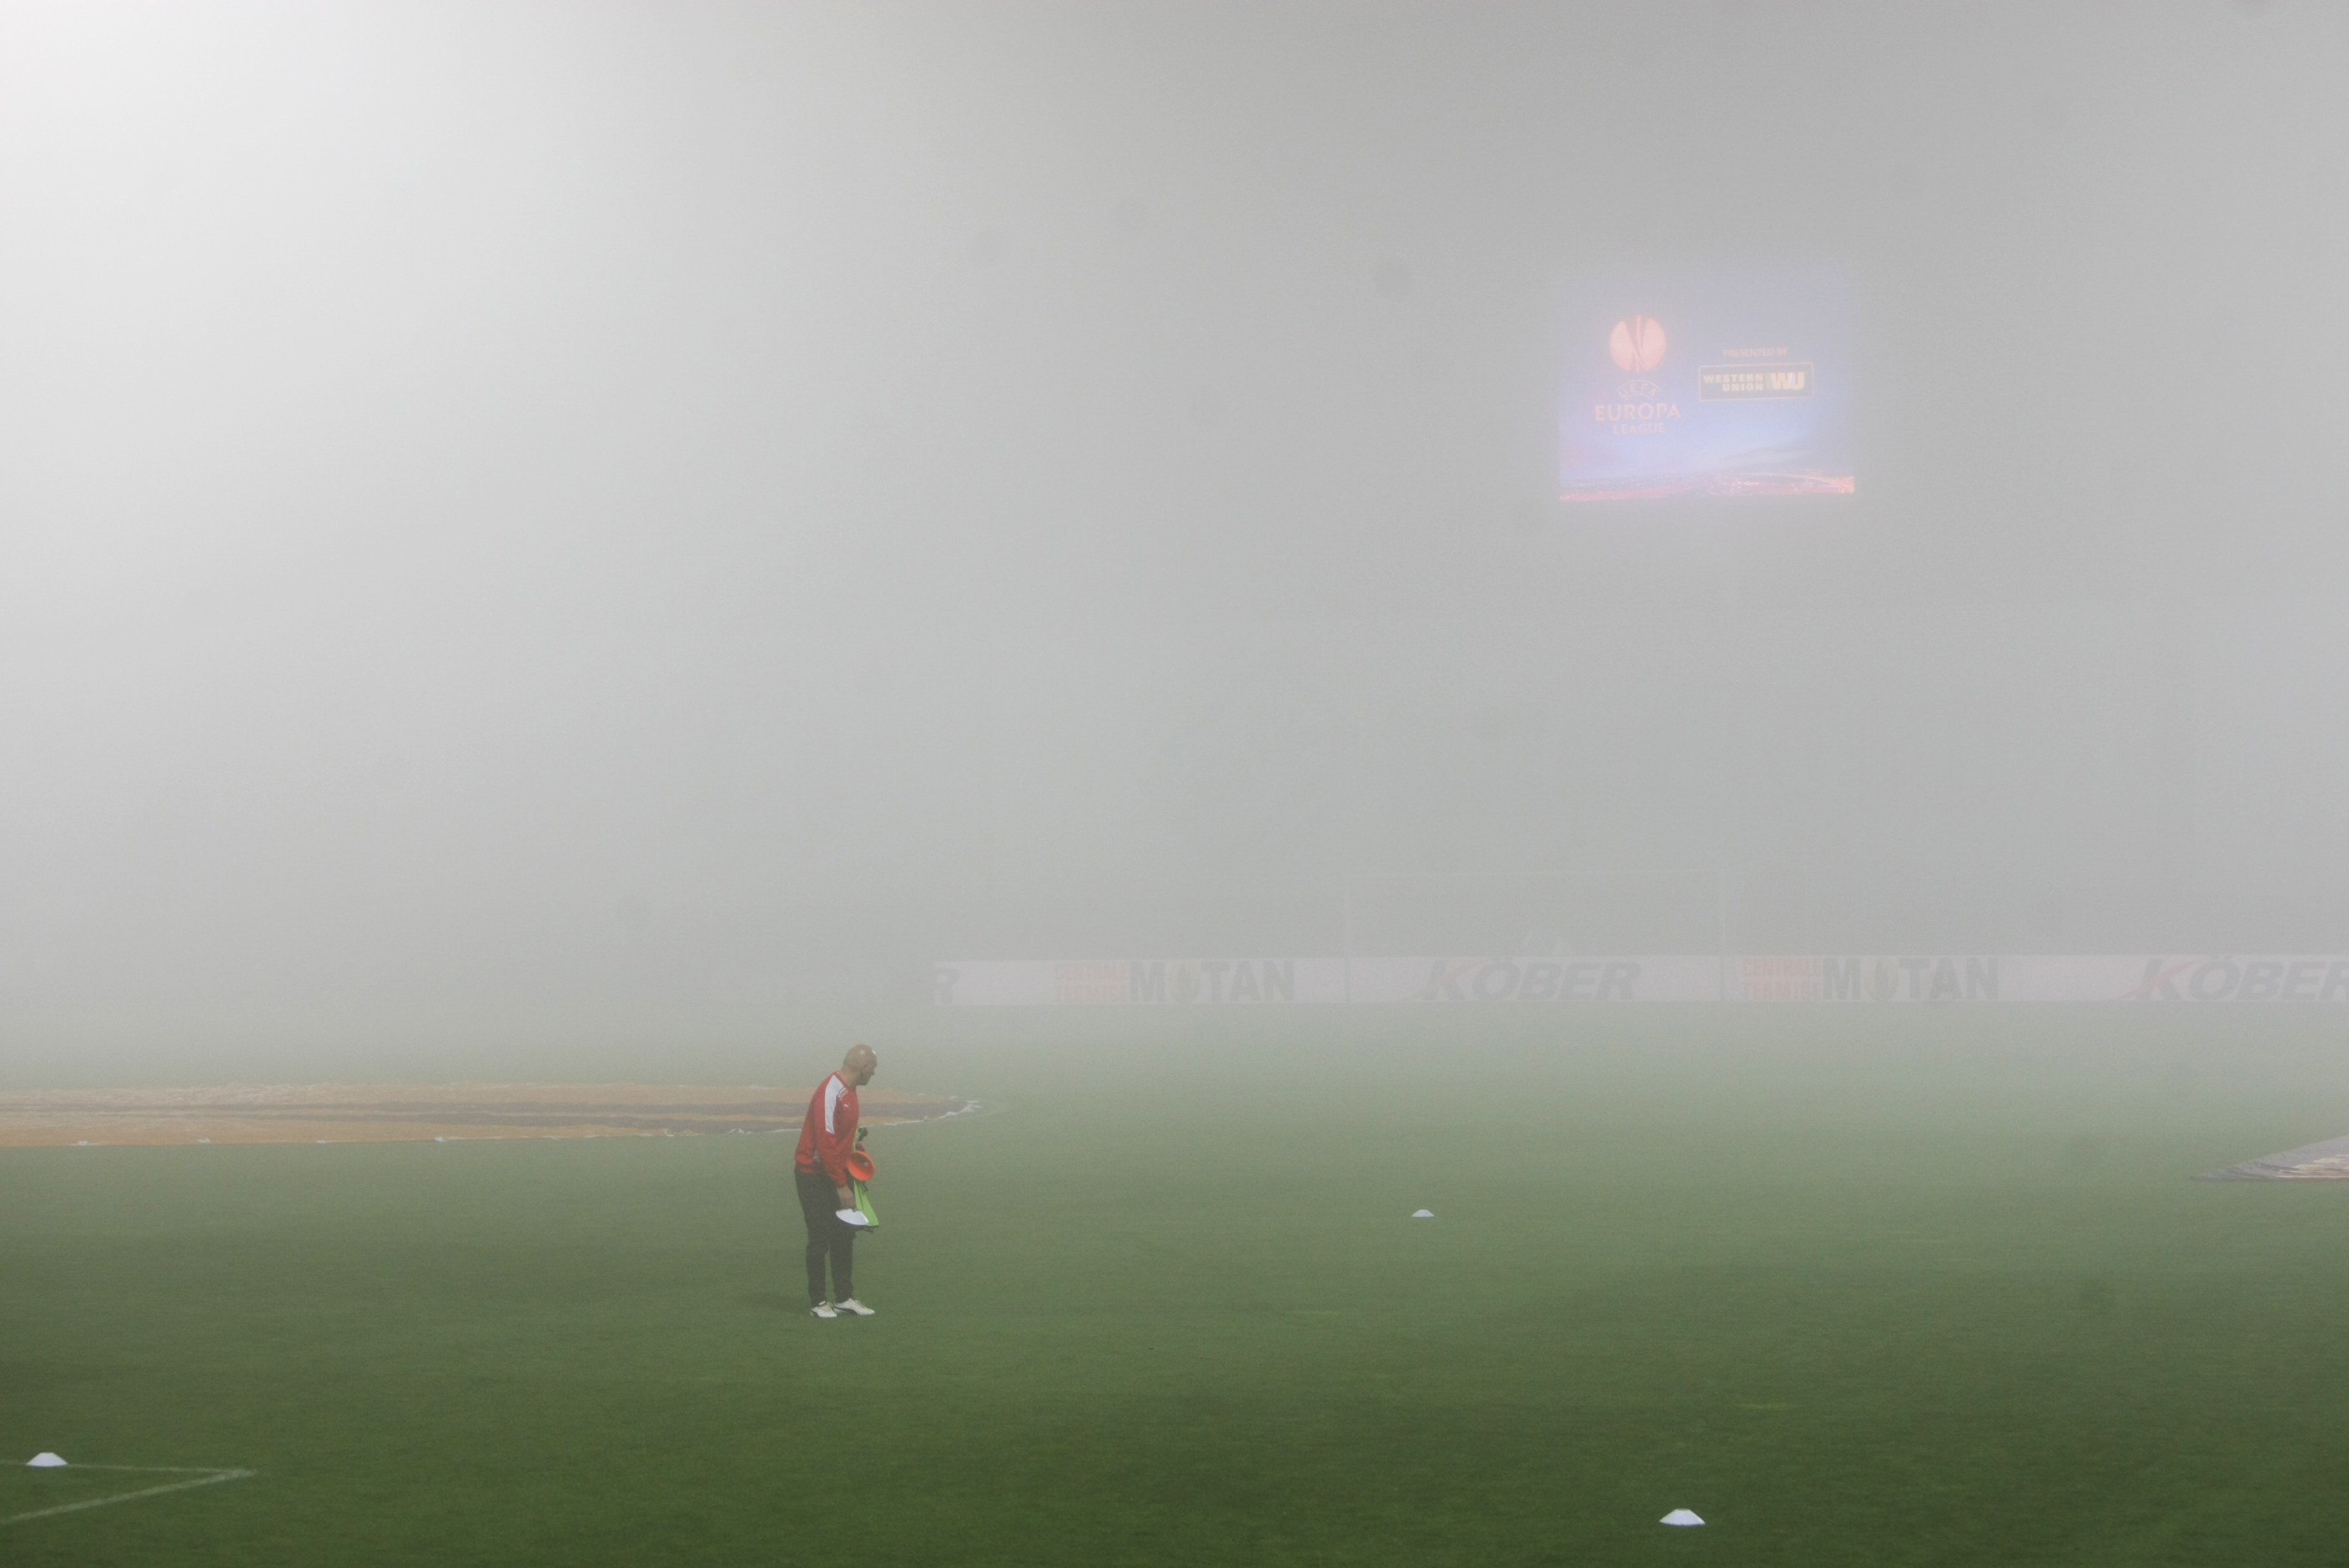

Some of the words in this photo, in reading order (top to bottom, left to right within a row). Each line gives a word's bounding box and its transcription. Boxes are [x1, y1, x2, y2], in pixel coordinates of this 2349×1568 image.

[1723, 348, 1775, 357] PRESENTED
[1777, 347, 1788, 356] BY
[1703, 374, 1763, 384] WESTERN
[1722, 383, 1763, 392] UNION
[1594, 402, 1682, 422] EUROPA
[1612, 424, 1666, 435] LEAGUE
[1418, 956, 1641, 1001] KÖBER
